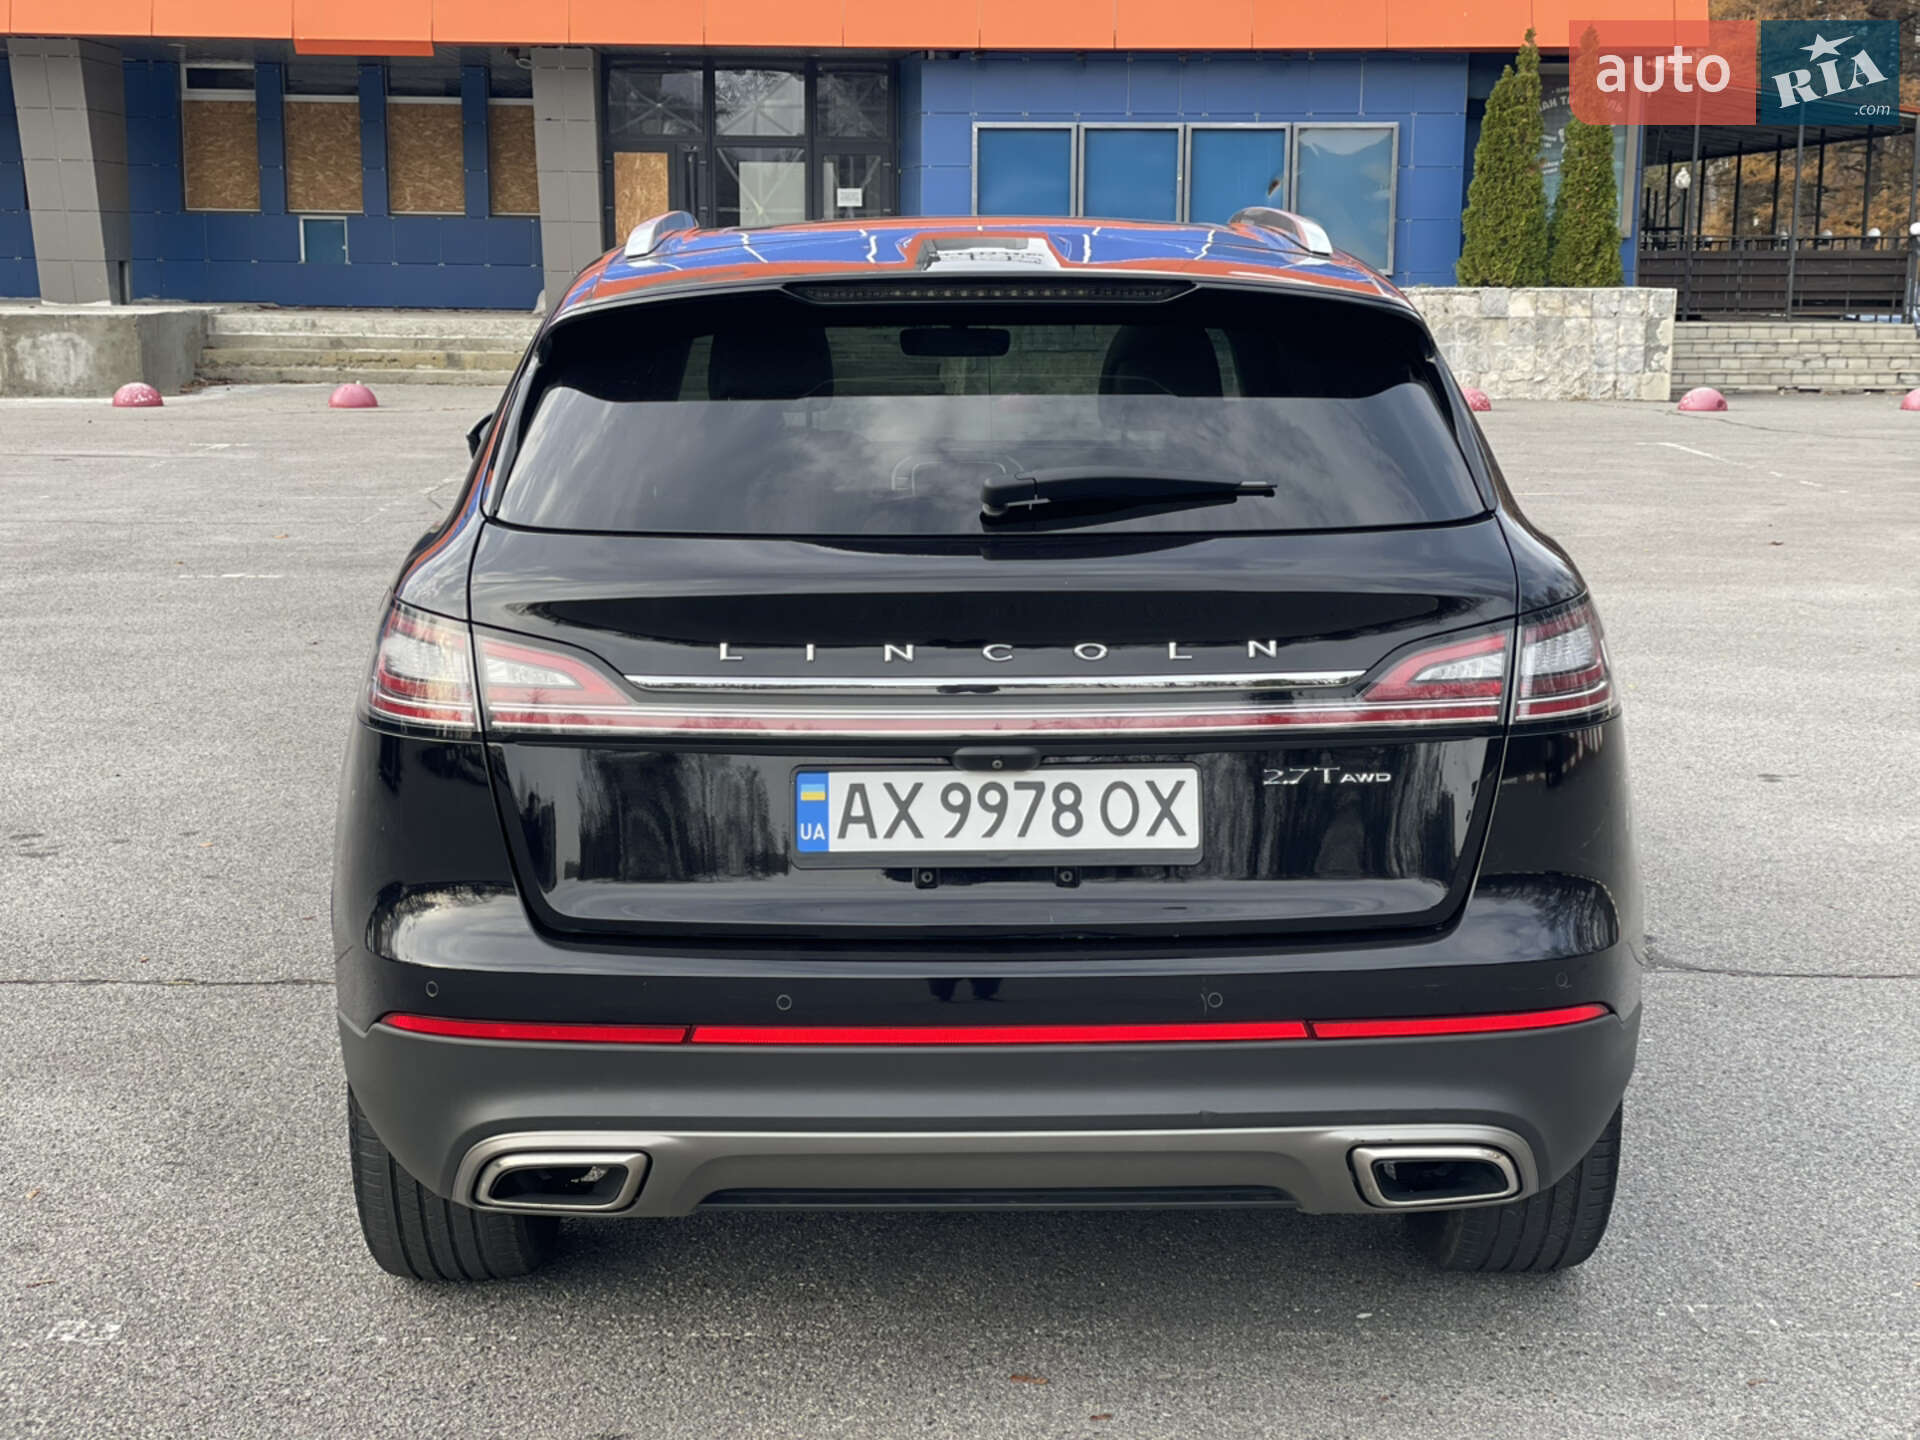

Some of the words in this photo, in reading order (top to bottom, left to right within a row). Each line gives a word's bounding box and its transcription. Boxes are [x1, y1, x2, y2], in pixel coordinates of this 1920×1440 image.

[719, 640, 1277, 662] LINCOLN
[1340, 772, 1392, 784] AWD
[837, 782, 924, 839] AX
[940, 781, 1084, 839] 9978
[1100, 780, 1188, 838] OX
[800, 823, 826, 841] UA
